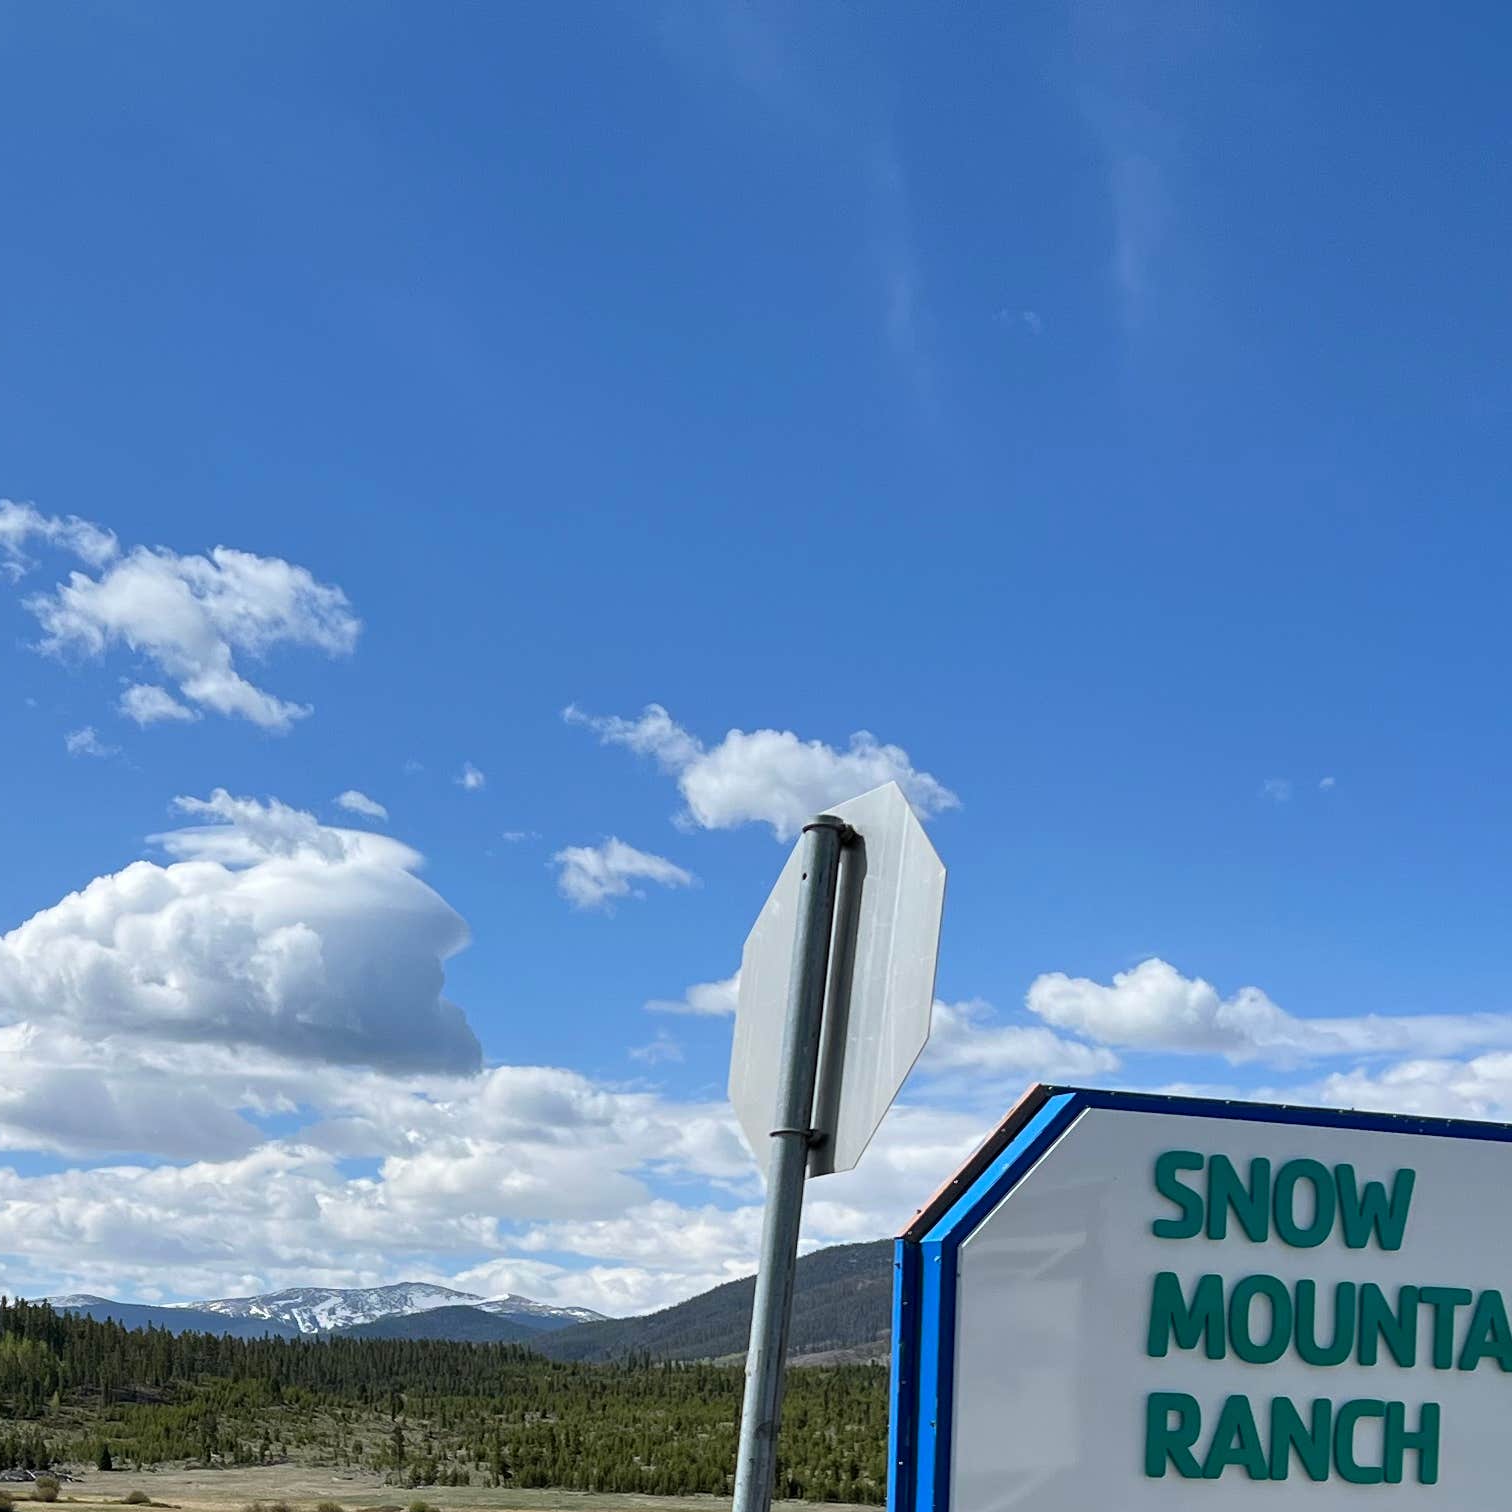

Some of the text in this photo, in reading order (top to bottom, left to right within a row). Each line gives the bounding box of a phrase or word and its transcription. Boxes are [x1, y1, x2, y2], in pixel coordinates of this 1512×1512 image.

[1152, 1149, 1416, 1251] SNOW
[1146, 1271, 1512, 1372] MOUNTA
[1144, 1391, 1440, 1485] RANCH
